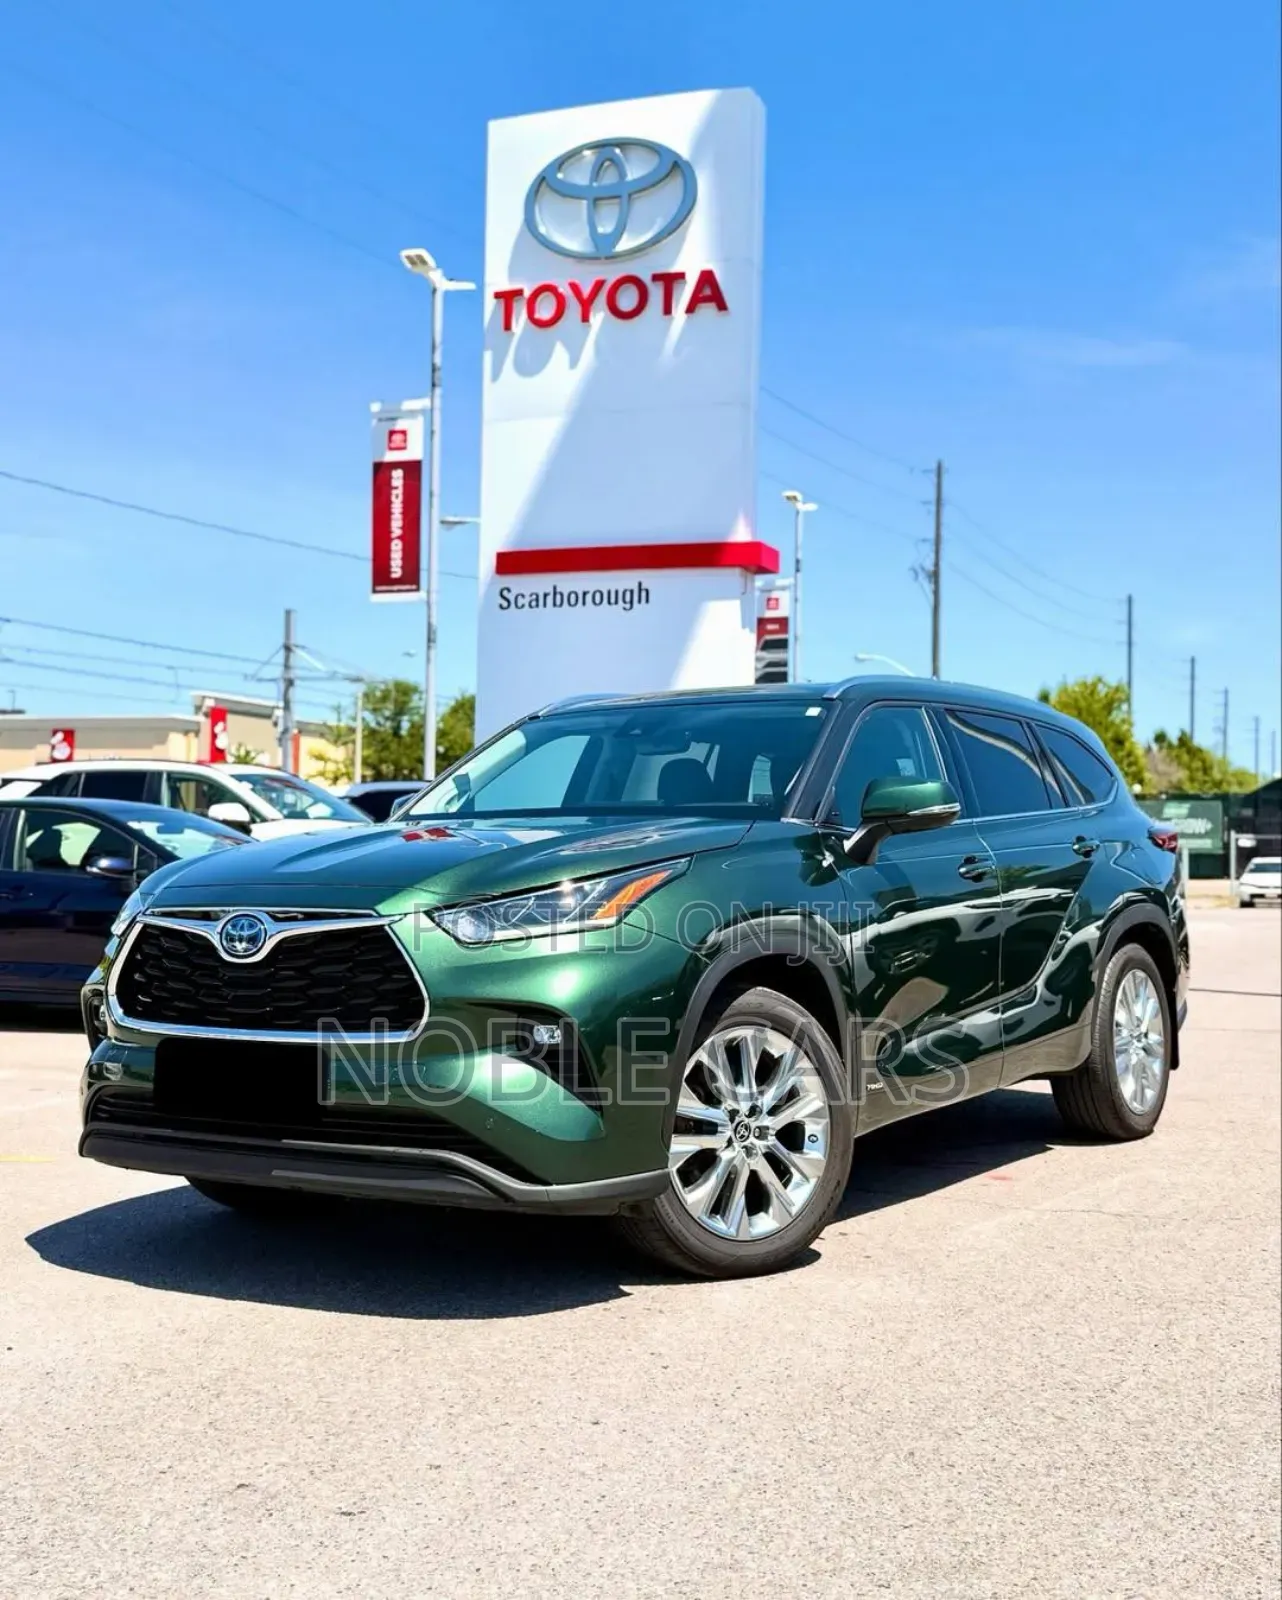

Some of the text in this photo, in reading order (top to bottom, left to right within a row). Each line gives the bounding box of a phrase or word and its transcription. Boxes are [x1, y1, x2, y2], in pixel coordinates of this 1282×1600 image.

[493, 269, 728, 332] TOYOTA
[390, 468, 404, 579] USED VEHICLES
[498, 580, 650, 611] Scarborough
